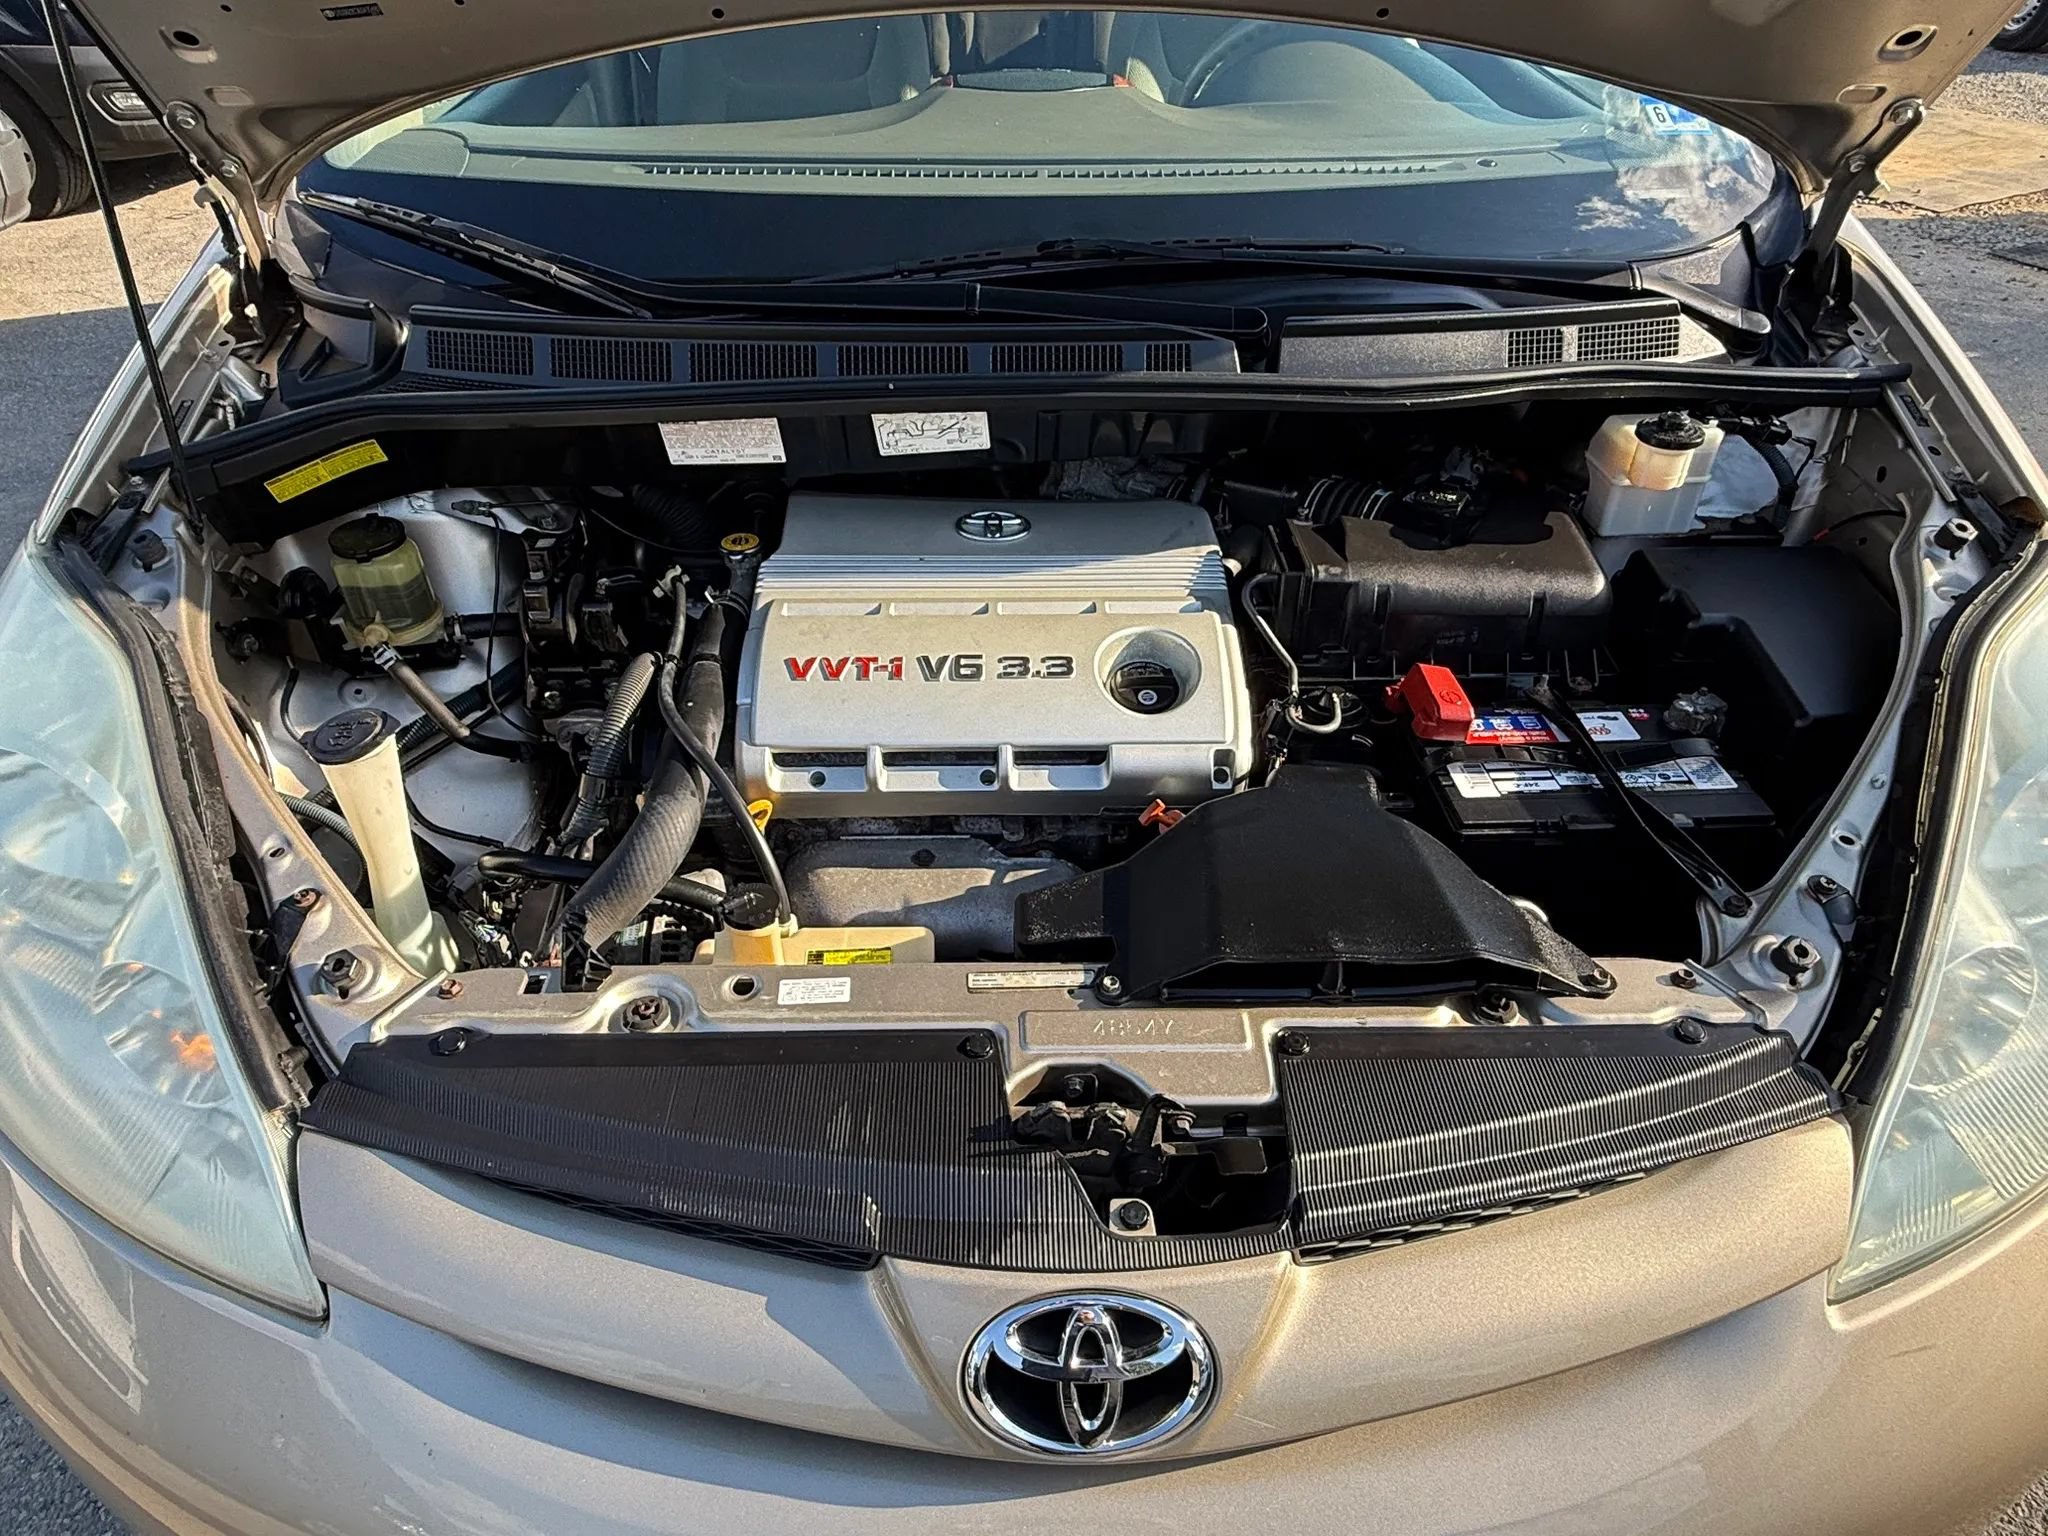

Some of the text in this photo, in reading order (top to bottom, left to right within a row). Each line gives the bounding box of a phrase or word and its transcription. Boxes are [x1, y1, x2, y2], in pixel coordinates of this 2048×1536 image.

[1652, 106, 1667, 123] 6
[916, 654, 985, 682] V6
[996, 655, 1075, 680] 3.3
